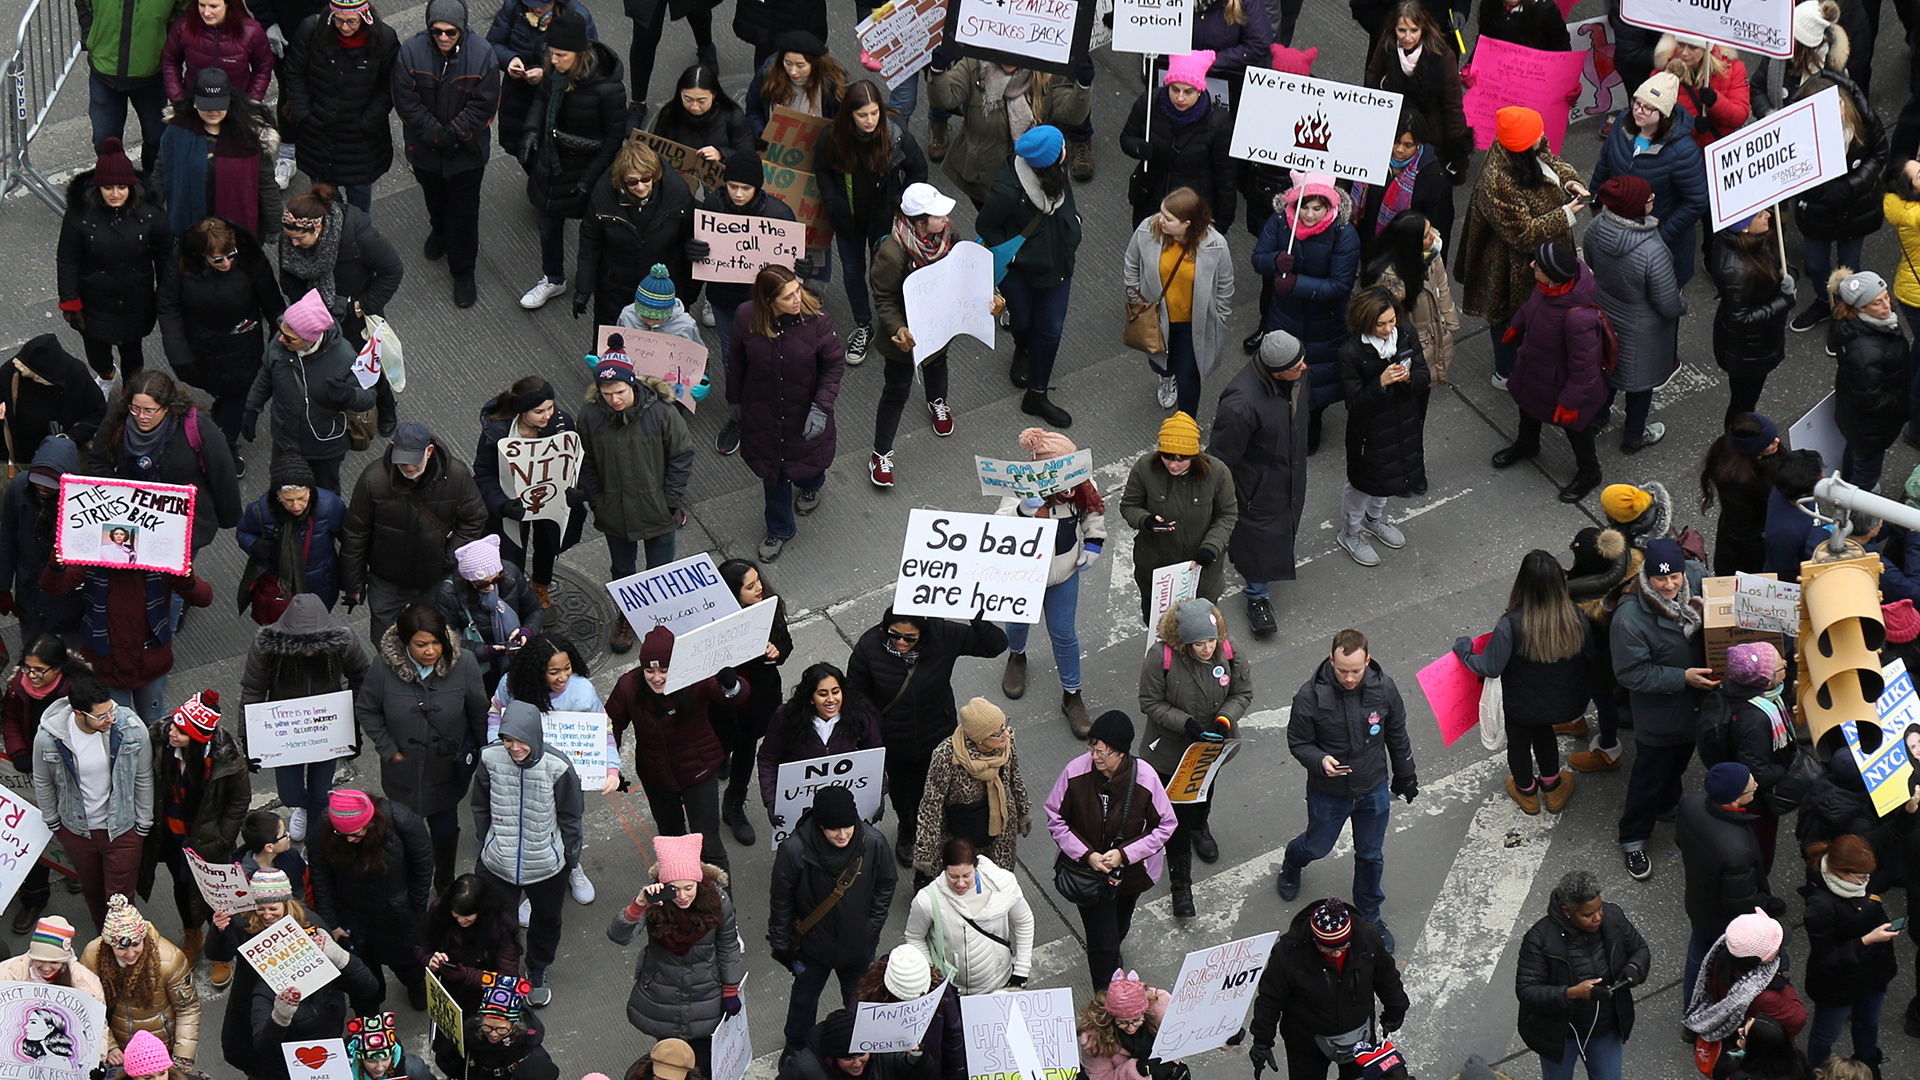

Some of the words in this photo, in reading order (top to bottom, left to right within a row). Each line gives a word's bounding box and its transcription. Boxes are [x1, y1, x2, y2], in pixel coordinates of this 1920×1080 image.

[961, 16, 1025, 40] STRIKES
[1026, 22, 1068, 46] BACK
[1130, 12, 1182, 27] option!
[1733, 28, 1786, 46] STRONG
[17, 77, 26, 117] NYPD
[1248, 71, 1296, 92] We're
[1300, 82, 1325, 97] the
[1333, 89, 1394, 109] witches
[765, 142, 805, 167] NO
[1247, 145, 1277, 161] you
[1284, 152, 1325, 170] didn't
[1333, 160, 1368, 178] burn
[1721, 146, 1741, 170] MY
[1746, 127, 1782, 158] BODY
[1723, 167, 1744, 191] MY
[1748, 142, 1797, 179] CHOICE
[701, 213, 749, 234] Heed
[759, 220, 786, 236] the
[738, 255, 754, 269] for
[981, 461, 996, 472] I
[1006, 464, 1035, 475] AM
[1043, 456, 1075, 473] NOT
[1013, 470, 1058, 482] FREE
[981, 476, 1031, 490] UNTIL
[68, 485, 111, 508] THE
[130, 488, 191, 516] FEMPIRE
[70, 496, 130, 528] STRIKES
[127, 507, 165, 532] BACK
[926, 518, 967, 551] So
[978, 522, 1044, 559] bad,
[902, 558, 958, 579] even
[618, 561, 718, 612] ANYTHING
[912, 584, 961, 606] are
[970, 581, 1029, 617] here.
[1156, 573, 1171, 614] minds
[675, 606, 700, 621] can
[702, 597, 716, 611] do
[1738, 613, 1756, 627] We
[1757, 618, 1777, 630] Are
[1741, 598, 1787, 618] Nuestra
[717, 622, 750, 646] WITH
[702, 645, 733, 671] HER
[264, 721, 273, 729] to
[313, 714, 337, 723] women
[546, 717, 557, 731] the
[558, 722, 575, 733] power
[578, 721, 585, 731] to
[586, 722, 599, 731] have
[308, 738, 328, 747] Obama
[804, 758, 853, 779] NO
[1184, 743, 1222, 794] POWE
[1865, 748, 1906, 788] NYC
[1, 829, 30, 858] fun
[246, 923, 296, 959] PEOPLE
[253, 945, 279, 965] HAVE
[281, 930, 301, 946] THE
[1206, 938, 1256, 968] OUR
[265, 969, 277, 979] TO
[278, 945, 314, 971] REDEEM
[271, 970, 290, 985] THE
[290, 951, 319, 973] WORK
[276, 980, 289, 991] OF
[291, 957, 324, 982] FOOLS
[1183, 953, 1263, 989] RIGHTS
[33, 987, 51, 1000] OUR
[1171, 982, 1207, 1005] ARE
[1221, 966, 1263, 990] NOT
[1176, 994, 1204, 1015] UP
[1211, 983, 1247, 1006] FOR
[862, 994, 935, 1021] TANTRUMS
[901, 1015, 917, 1026] ARE
[993, 992, 1052, 1020] YOU
[860, 1041, 892, 1051] OPEN
[973, 1016, 1075, 1050] HAEN'T
[1157, 1015, 1242, 1057] Grabs
[29, 1066, 45, 1080] OUR
[984, 1043, 1061, 1073] SEN
